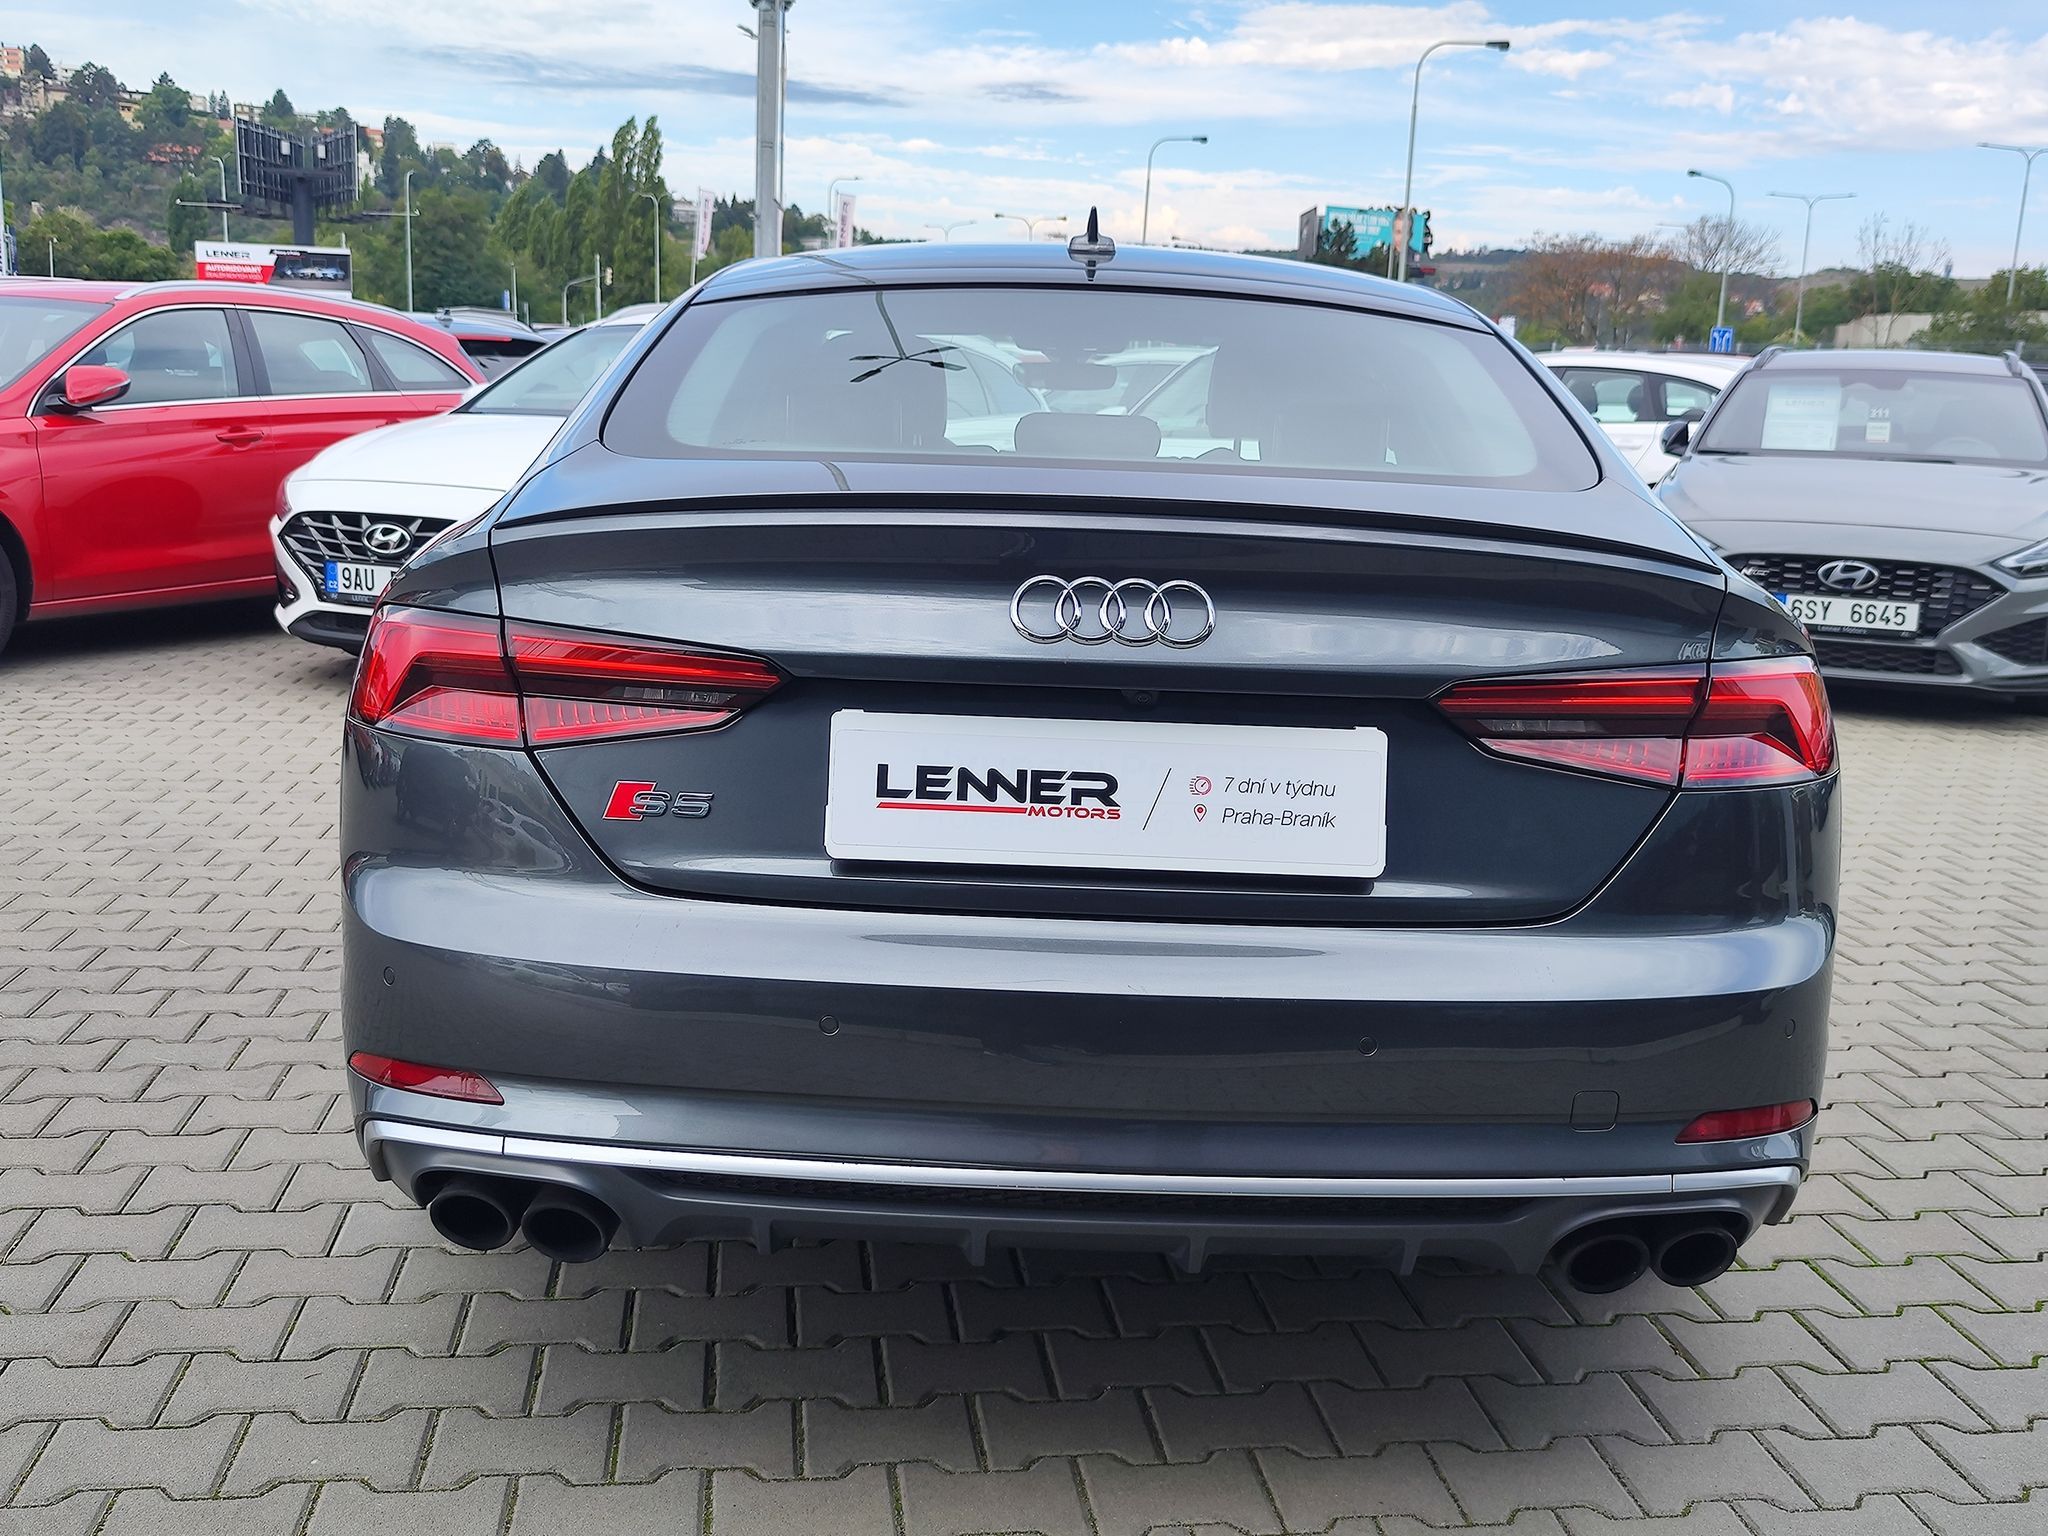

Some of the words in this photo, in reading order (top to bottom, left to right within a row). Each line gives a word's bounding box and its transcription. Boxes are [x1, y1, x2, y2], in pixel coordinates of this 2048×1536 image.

[206, 249, 250, 258] LENNER
[342, 567, 375, 591] 9AU
[1790, 599, 1832, 621] 6SY
[1850, 603, 1907, 626] 6645
[876, 763, 1121, 807] LENNER
[1224, 776, 1235, 793] 7
[1238, 777, 1267, 794] dní
[1270, 782, 1281, 794] v
[1285, 779, 1336, 799] týdnu
[628, 790, 714, 818] S5
[1028, 805, 1121, 820] MOTORS
[1222, 807, 1337, 828] Praha-Braník
